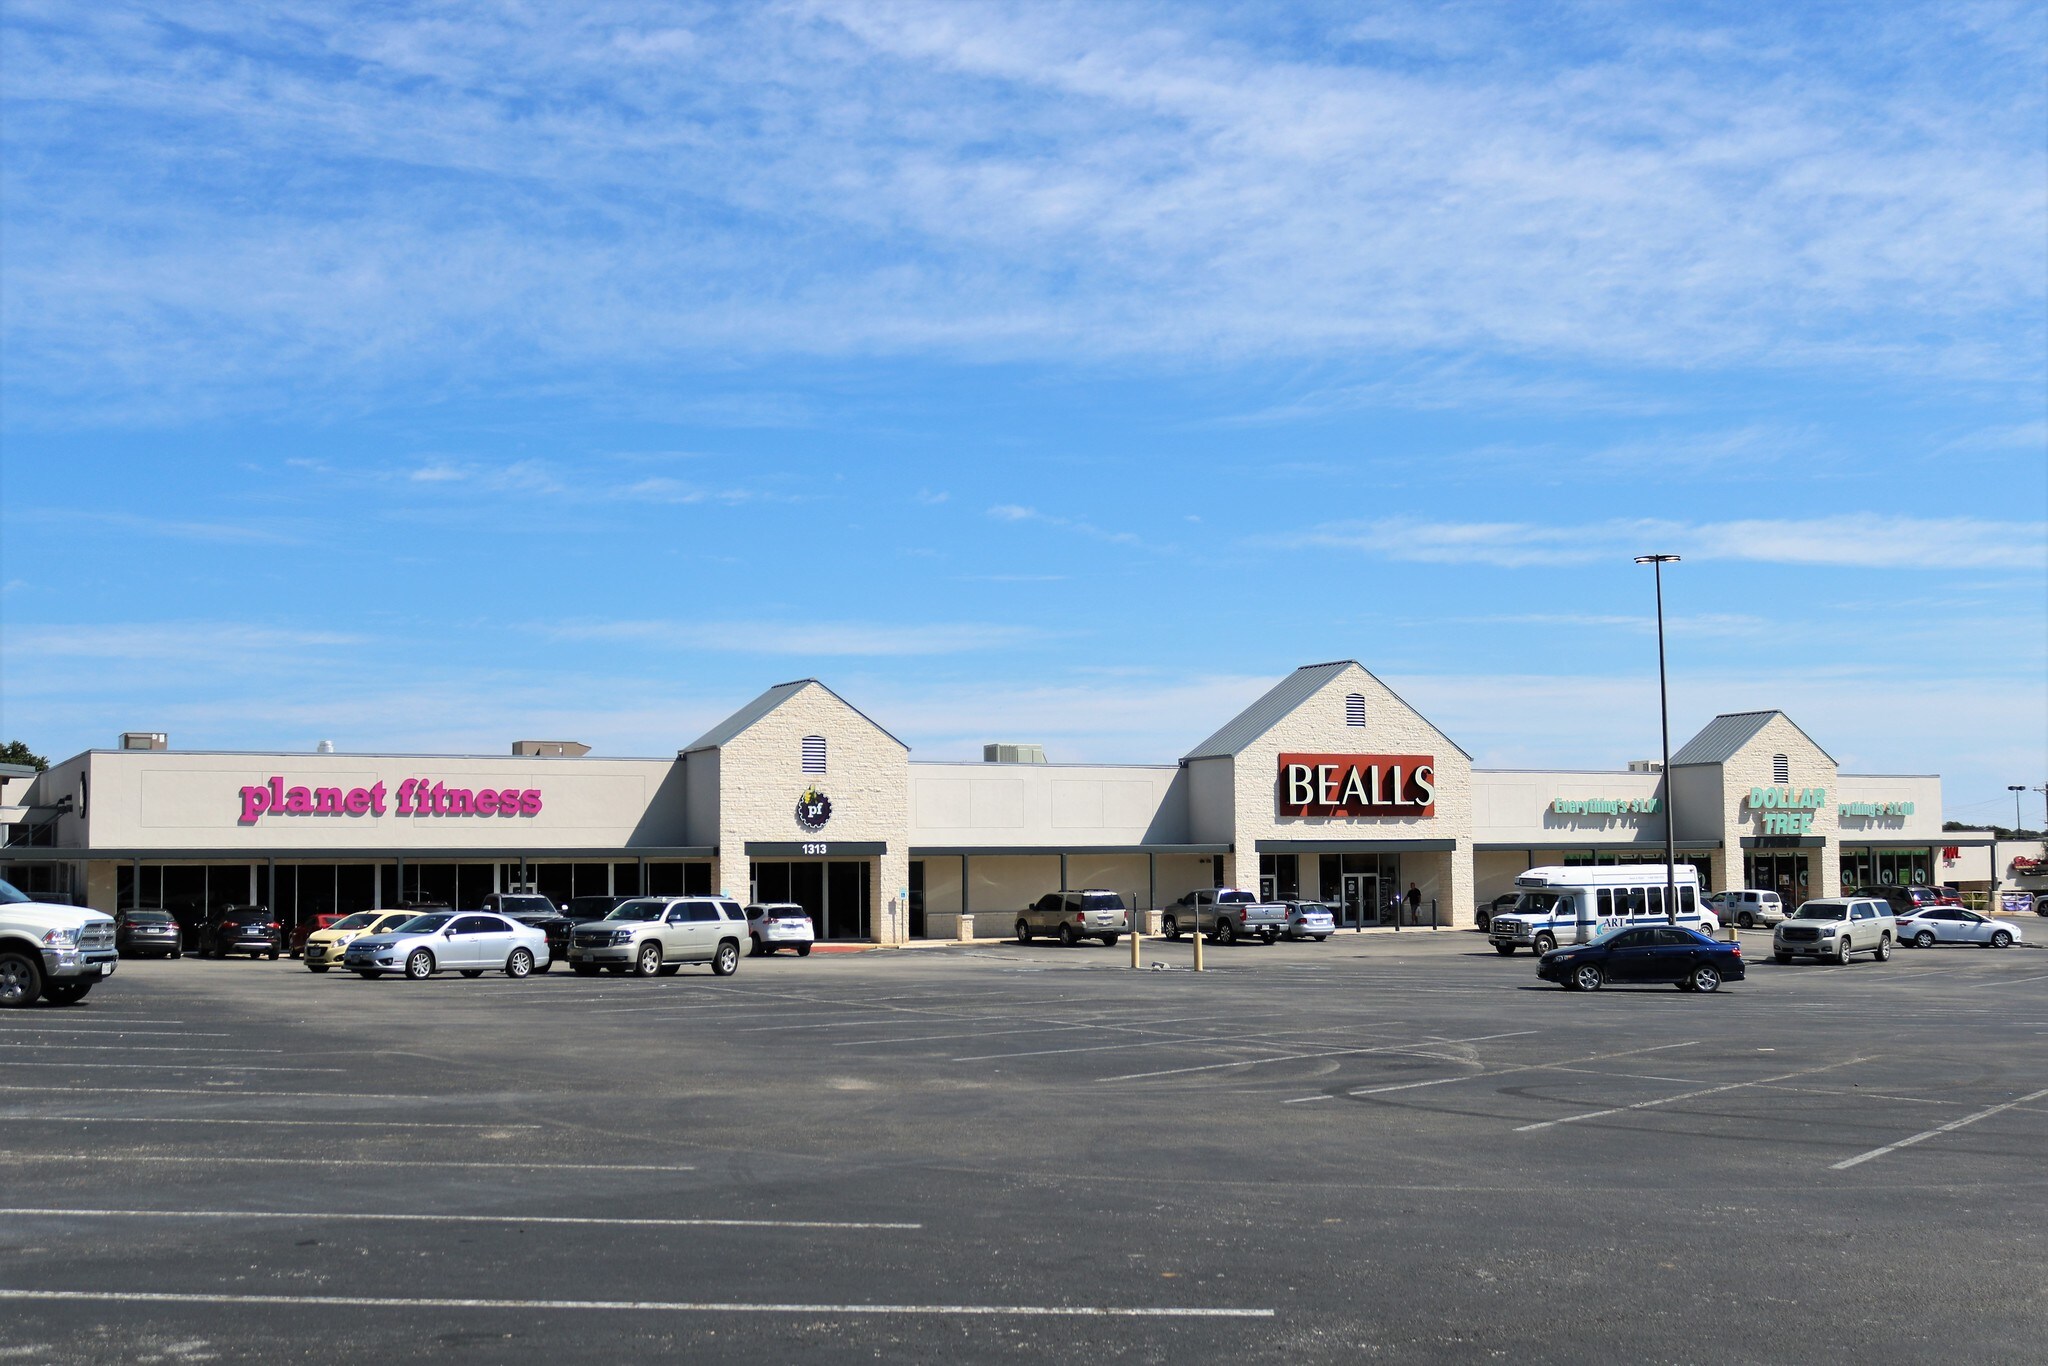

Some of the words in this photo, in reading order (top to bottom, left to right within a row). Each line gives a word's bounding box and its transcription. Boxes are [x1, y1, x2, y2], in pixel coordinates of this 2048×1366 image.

[1287, 763, 1435, 807] BEALLS
[240, 776, 388, 824] planet
[396, 777, 543, 815] fitness
[1554, 797, 1628, 816] Everything's
[1749, 787, 1826, 809] DOLLAR
[808, 802, 824, 818] pf
[1763, 813, 1813, 835] TREE
[802, 843, 827, 855] 1313
[1603, 917, 1625, 928] ART
